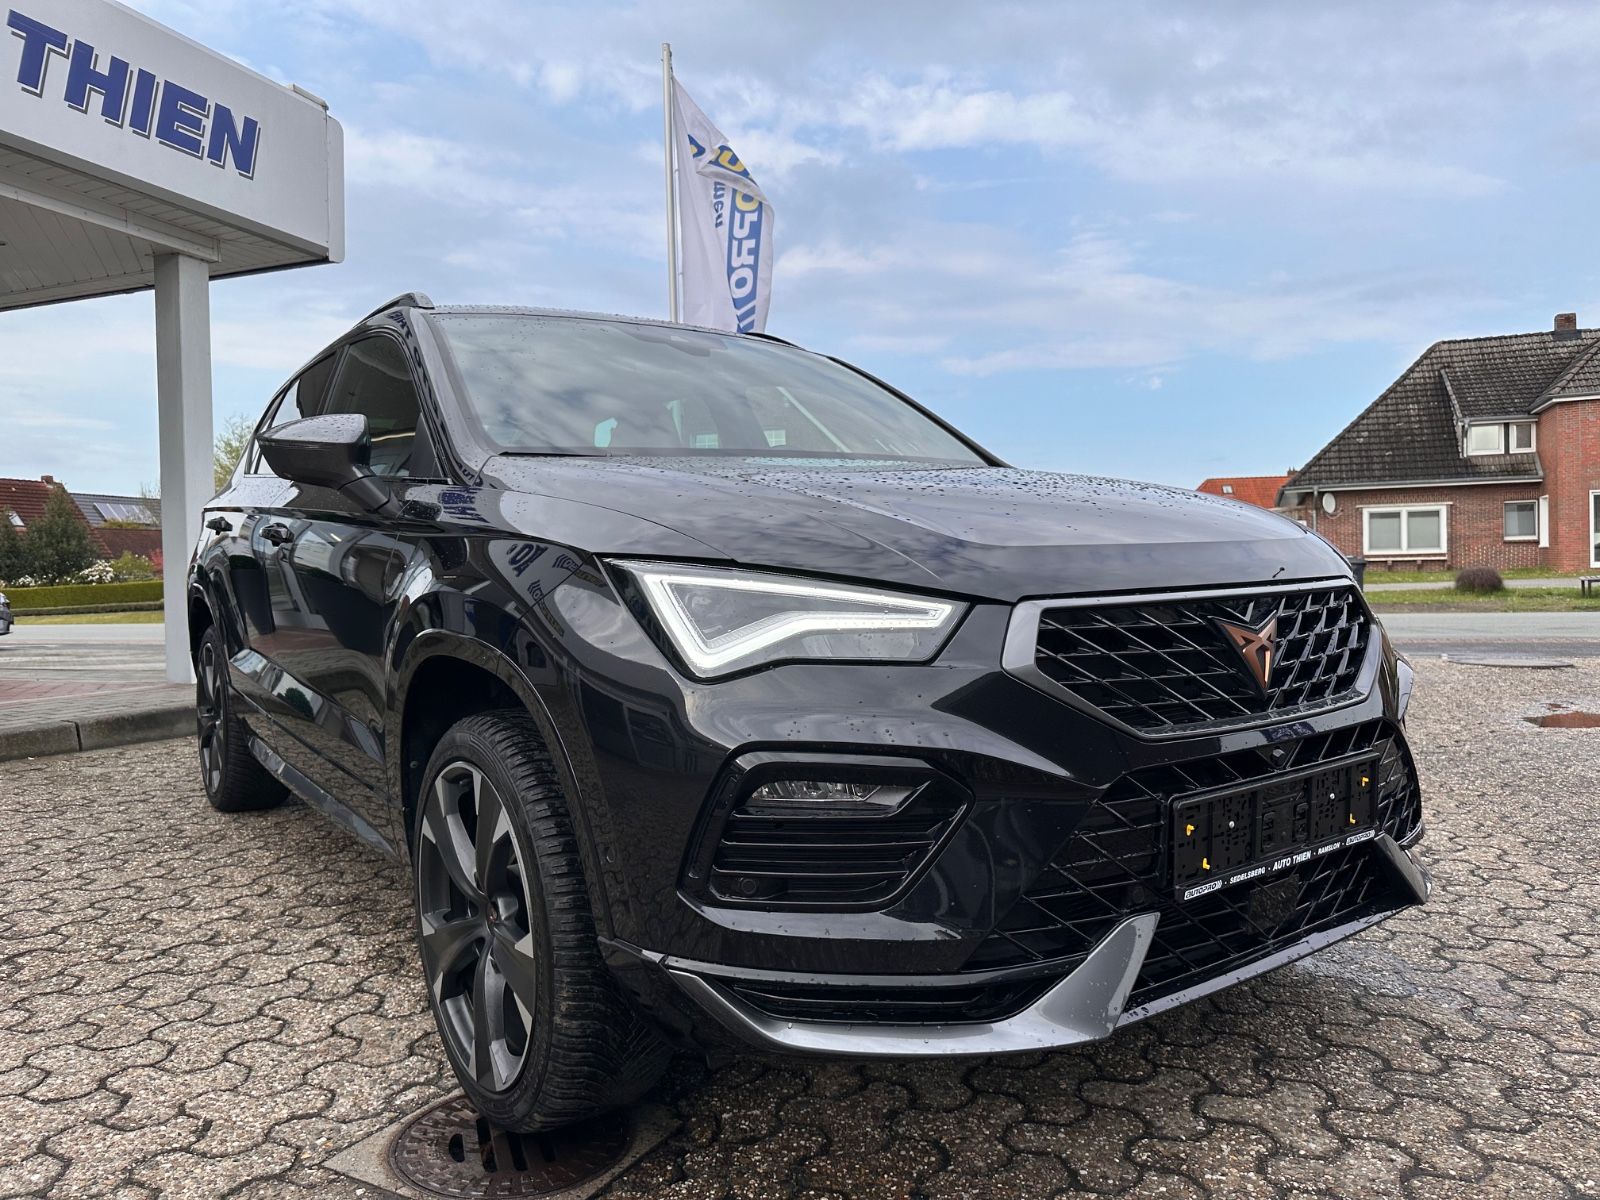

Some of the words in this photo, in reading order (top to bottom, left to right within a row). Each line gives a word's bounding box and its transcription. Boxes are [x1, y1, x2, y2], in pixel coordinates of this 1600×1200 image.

[6, 9, 260, 179] THIEN
[1230, 867, 1266, 884] SEDELSBERG
[1273, 858, 1291, 871] AUTO
[1293, 850, 1311, 865] THIEN
